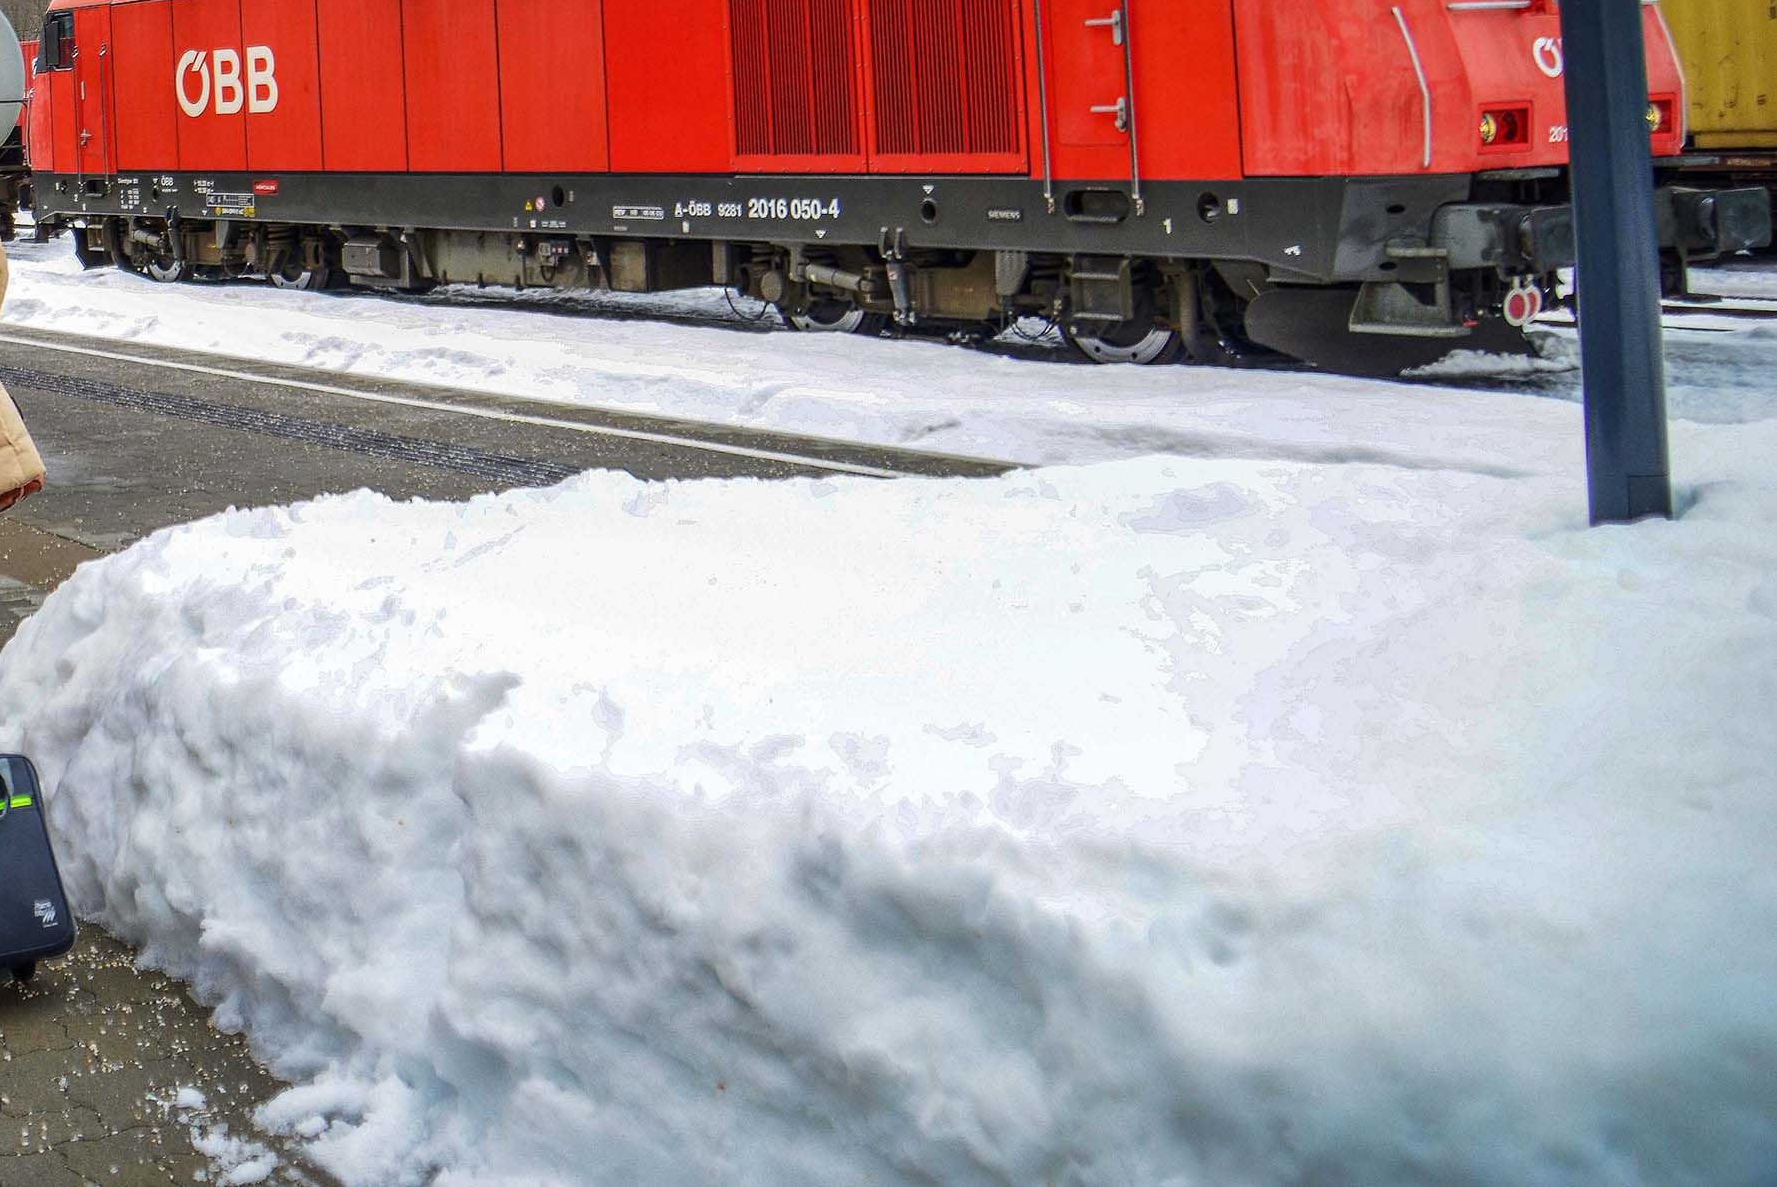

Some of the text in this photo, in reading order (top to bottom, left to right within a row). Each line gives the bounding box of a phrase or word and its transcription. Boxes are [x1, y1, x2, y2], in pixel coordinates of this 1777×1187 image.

[175, 46, 279, 118] ÖBB
[717, 202, 743, 218] 9281
[748, 198, 788, 220] 2016
[790, 198, 841, 220] 050-4
[988, 209, 1021, 220] SIEMENS
[1162, 216, 1173, 235] 1
